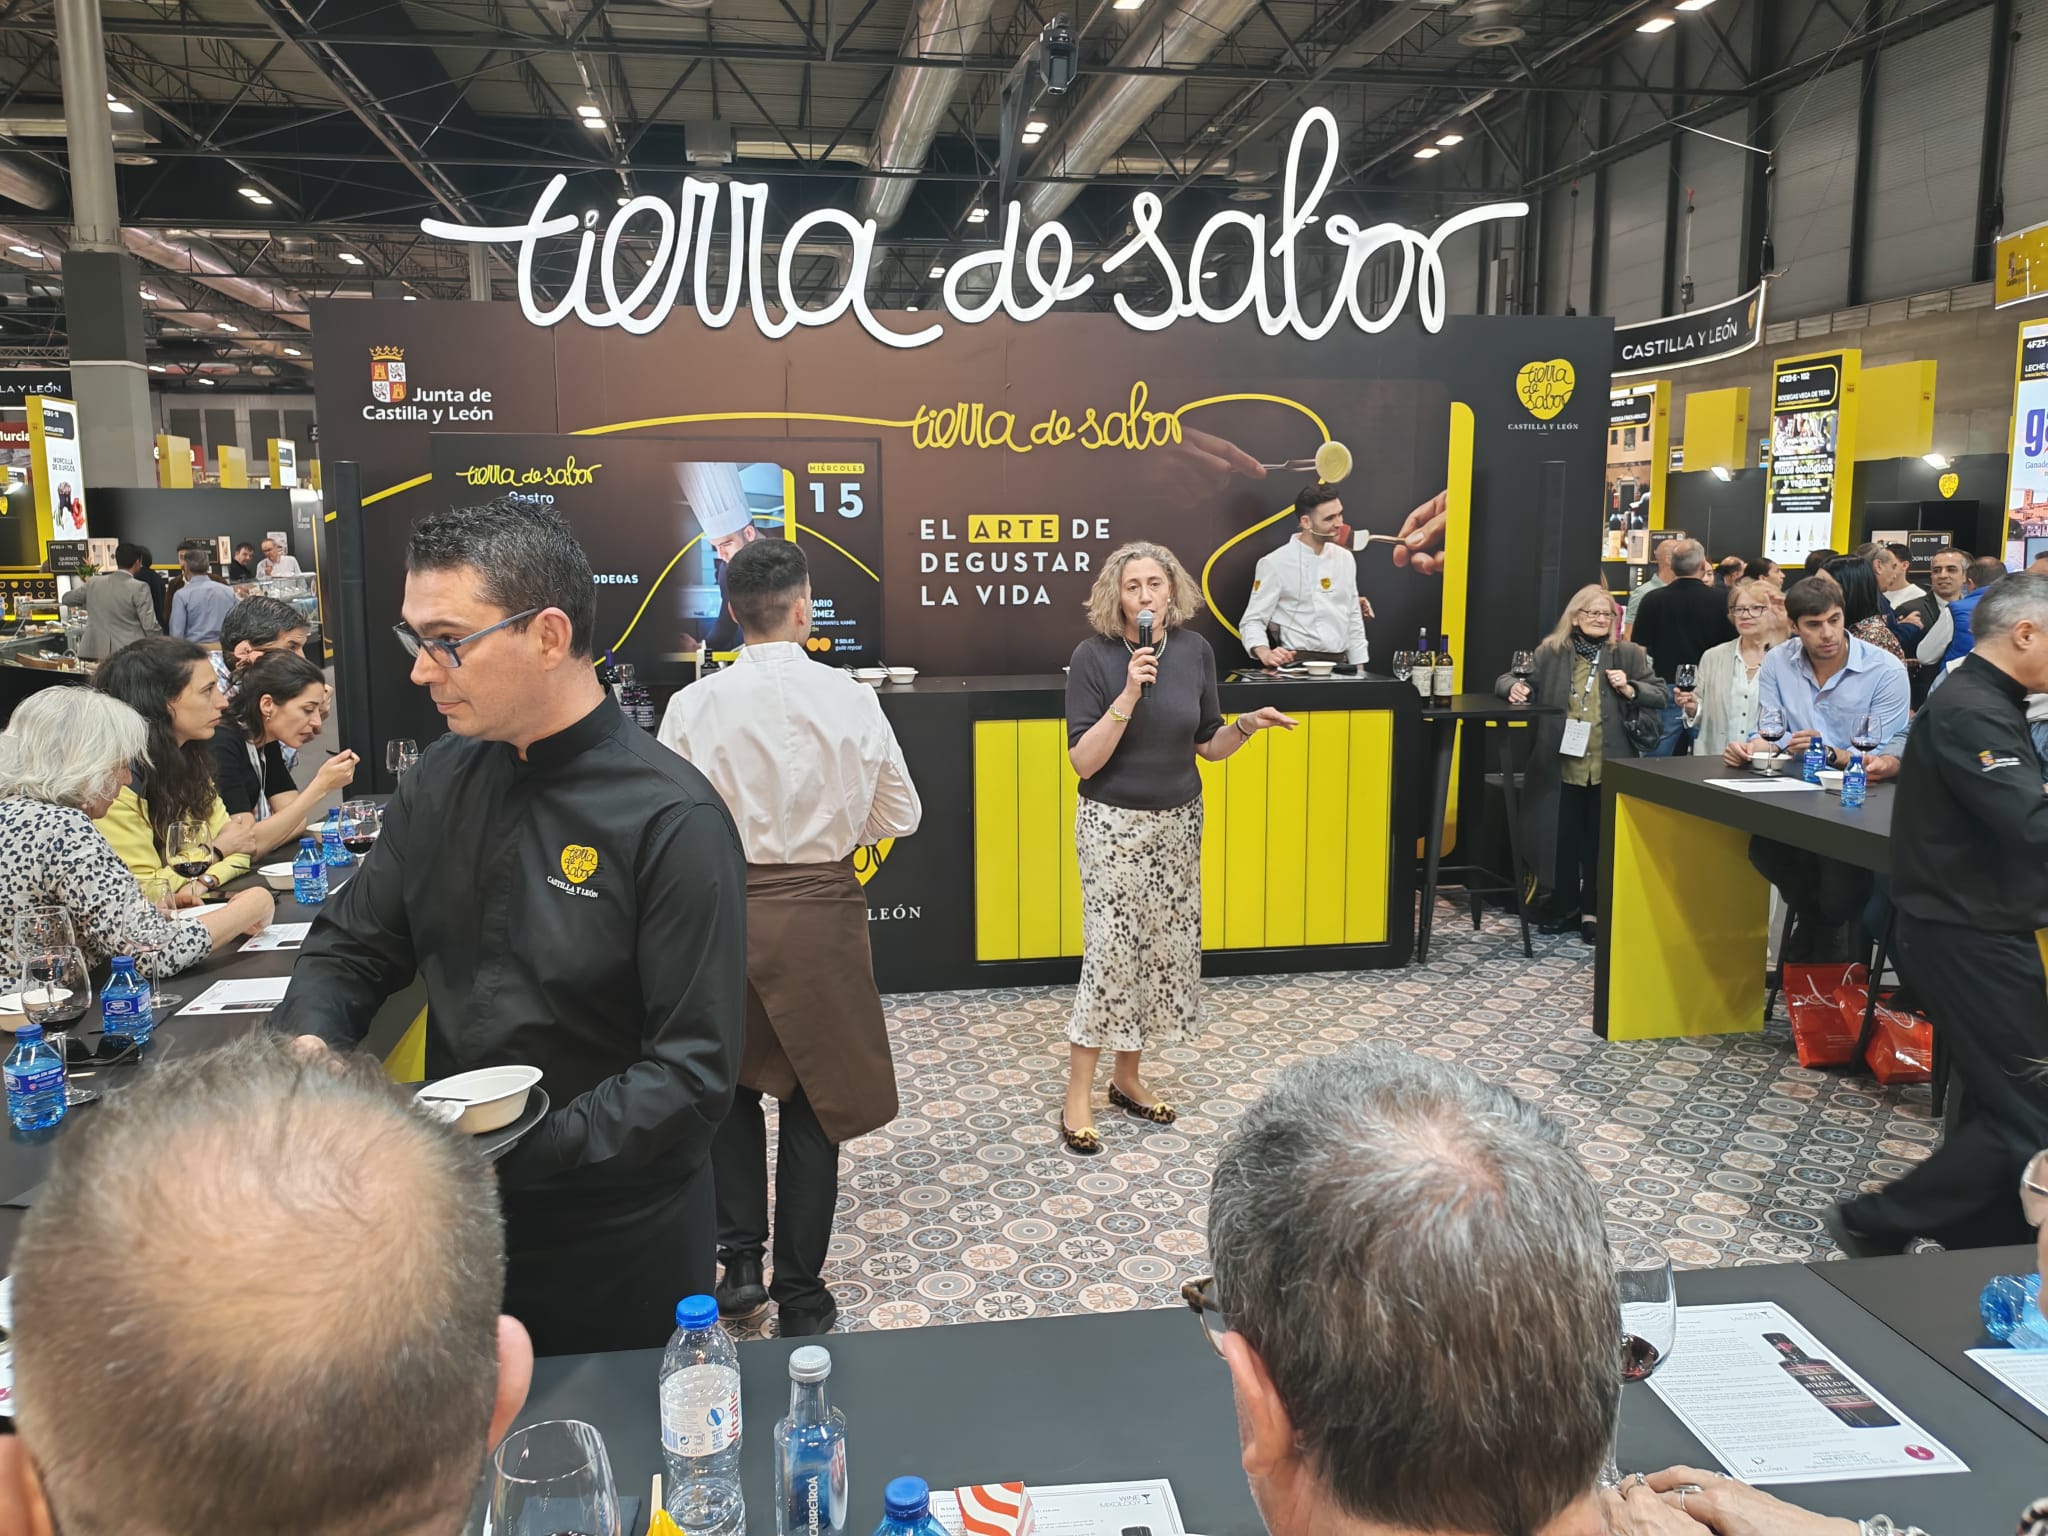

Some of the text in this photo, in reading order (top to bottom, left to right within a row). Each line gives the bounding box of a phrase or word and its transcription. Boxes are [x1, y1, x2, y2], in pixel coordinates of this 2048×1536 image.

[421, 106, 1530, 349] tierra de sabor
[1621, 316, 1739, 360] CASTILLA Y LEÓN
[1519, 365, 1573, 385] tierra
[17, 385, 26, 393] Y
[29, 381, 62, 393] LEÓN
[412, 387, 492, 402] Junta de
[1522, 382, 1540, 394] de
[1525, 383, 1575, 410] sabor
[362, 405, 493, 424] Castilla y León
[910, 380, 1184, 453] tierra de sabor
[1556, 422, 1579, 430] LEÓN
[456, 455, 603, 487] tierra de sabor
[809, 464, 864, 472] MIÉRCOLES
[920, 518, 1110, 541] EL ARTE DE
[920, 551, 1091, 574] DEGUSTAR
[593, 574, 640, 584] ODEGAS
[920, 584, 1051, 606] LA VIDA
[812, 608, 835, 618] ÓMEZ
[547, 875, 600, 898] CASTILLA Y LEÓN
[866, 903, 922, 921] LEÓN
